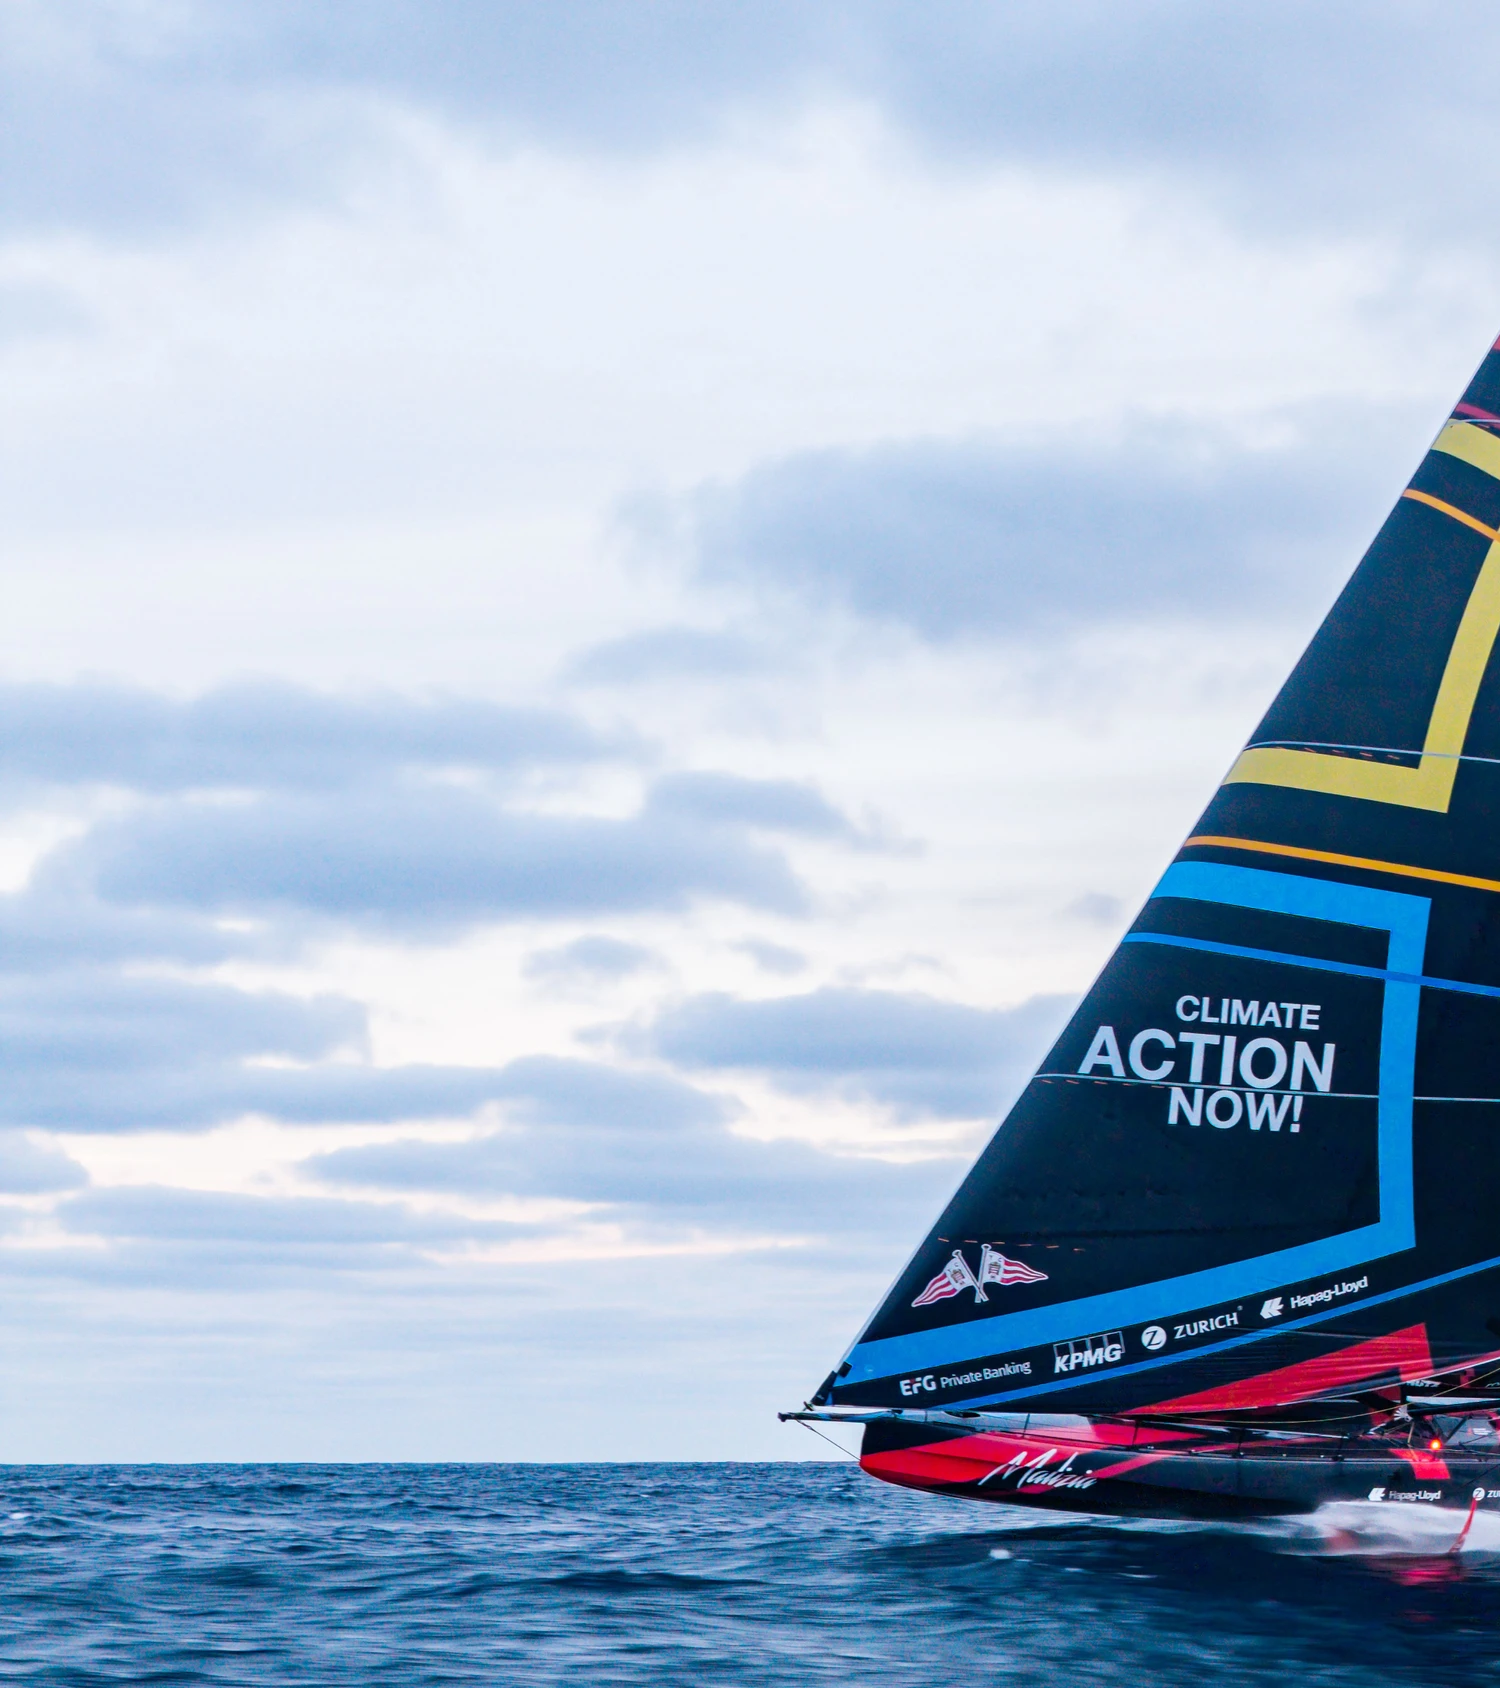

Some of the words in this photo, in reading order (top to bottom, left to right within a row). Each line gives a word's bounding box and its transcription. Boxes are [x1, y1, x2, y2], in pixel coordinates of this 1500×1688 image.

[1175, 995, 1321, 1031] CLIMATE
[1077, 1025, 1336, 1092] ACTION
[1167, 1087, 1304, 1133] NOW!
[1290, 1276, 1369, 1309] Hapag-Lloyd
[1172, 1312, 1239, 1340] ZURICH
[1054, 1343, 1122, 1374] KPMG
[899, 1374, 937, 1396] EFG
[940, 1372, 982, 1389] Private
[983, 1361, 1032, 1380] Banking
[1388, 1490, 1441, 1501] Hapag-Lloyd
